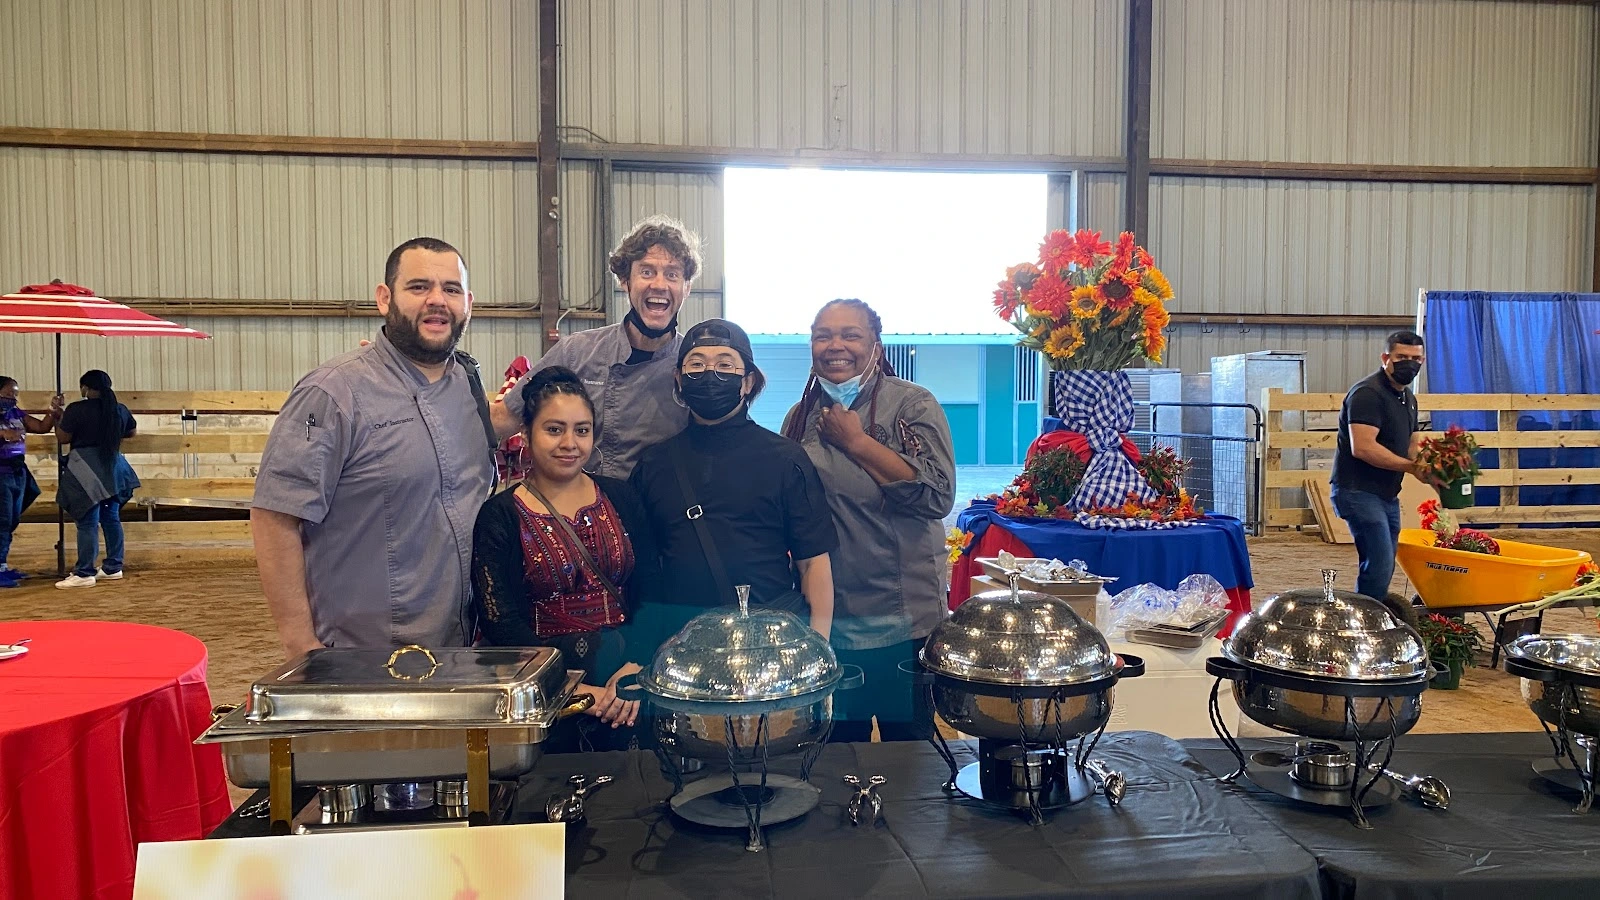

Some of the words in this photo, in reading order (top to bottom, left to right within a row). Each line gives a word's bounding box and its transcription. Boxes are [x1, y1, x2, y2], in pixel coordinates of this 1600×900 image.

[374, 421, 387, 429] Chef
[390, 417, 414, 426] Instructor
[1425, 561, 1441, 570] TRUE
[1443, 564, 1469, 574] TEMPER
